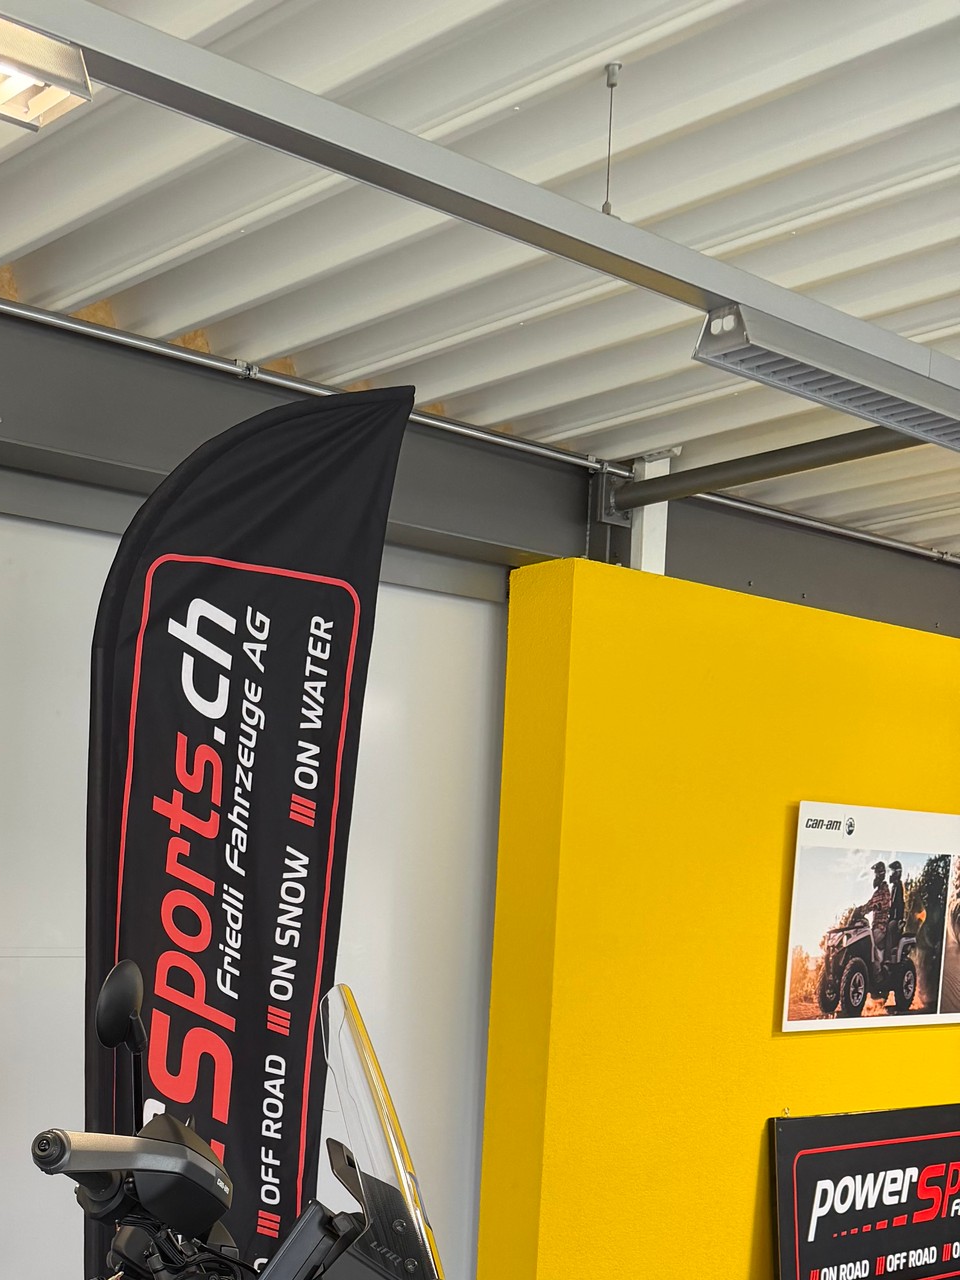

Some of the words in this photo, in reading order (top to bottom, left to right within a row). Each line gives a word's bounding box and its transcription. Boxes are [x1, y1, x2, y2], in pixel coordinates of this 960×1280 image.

[243, 605, 271, 673] AG
[299, 615, 334, 730] WATER
[225, 678, 265, 877] Fahrzeuge
[293, 739, 321, 791] ON
[143, 597, 238, 1127] Sports.ch
[804, 817, 842, 832] can-am
[274, 845, 311, 949] SNOW
[216, 882, 246, 1000] Friedli
[269, 953, 297, 1002] ON
[261, 1054, 288, 1145] ROAD
[259, 1147, 282, 1206] OFF
[886, 1252, 907, 1273] OFF
[908, 1246, 937, 1268] ROAD
